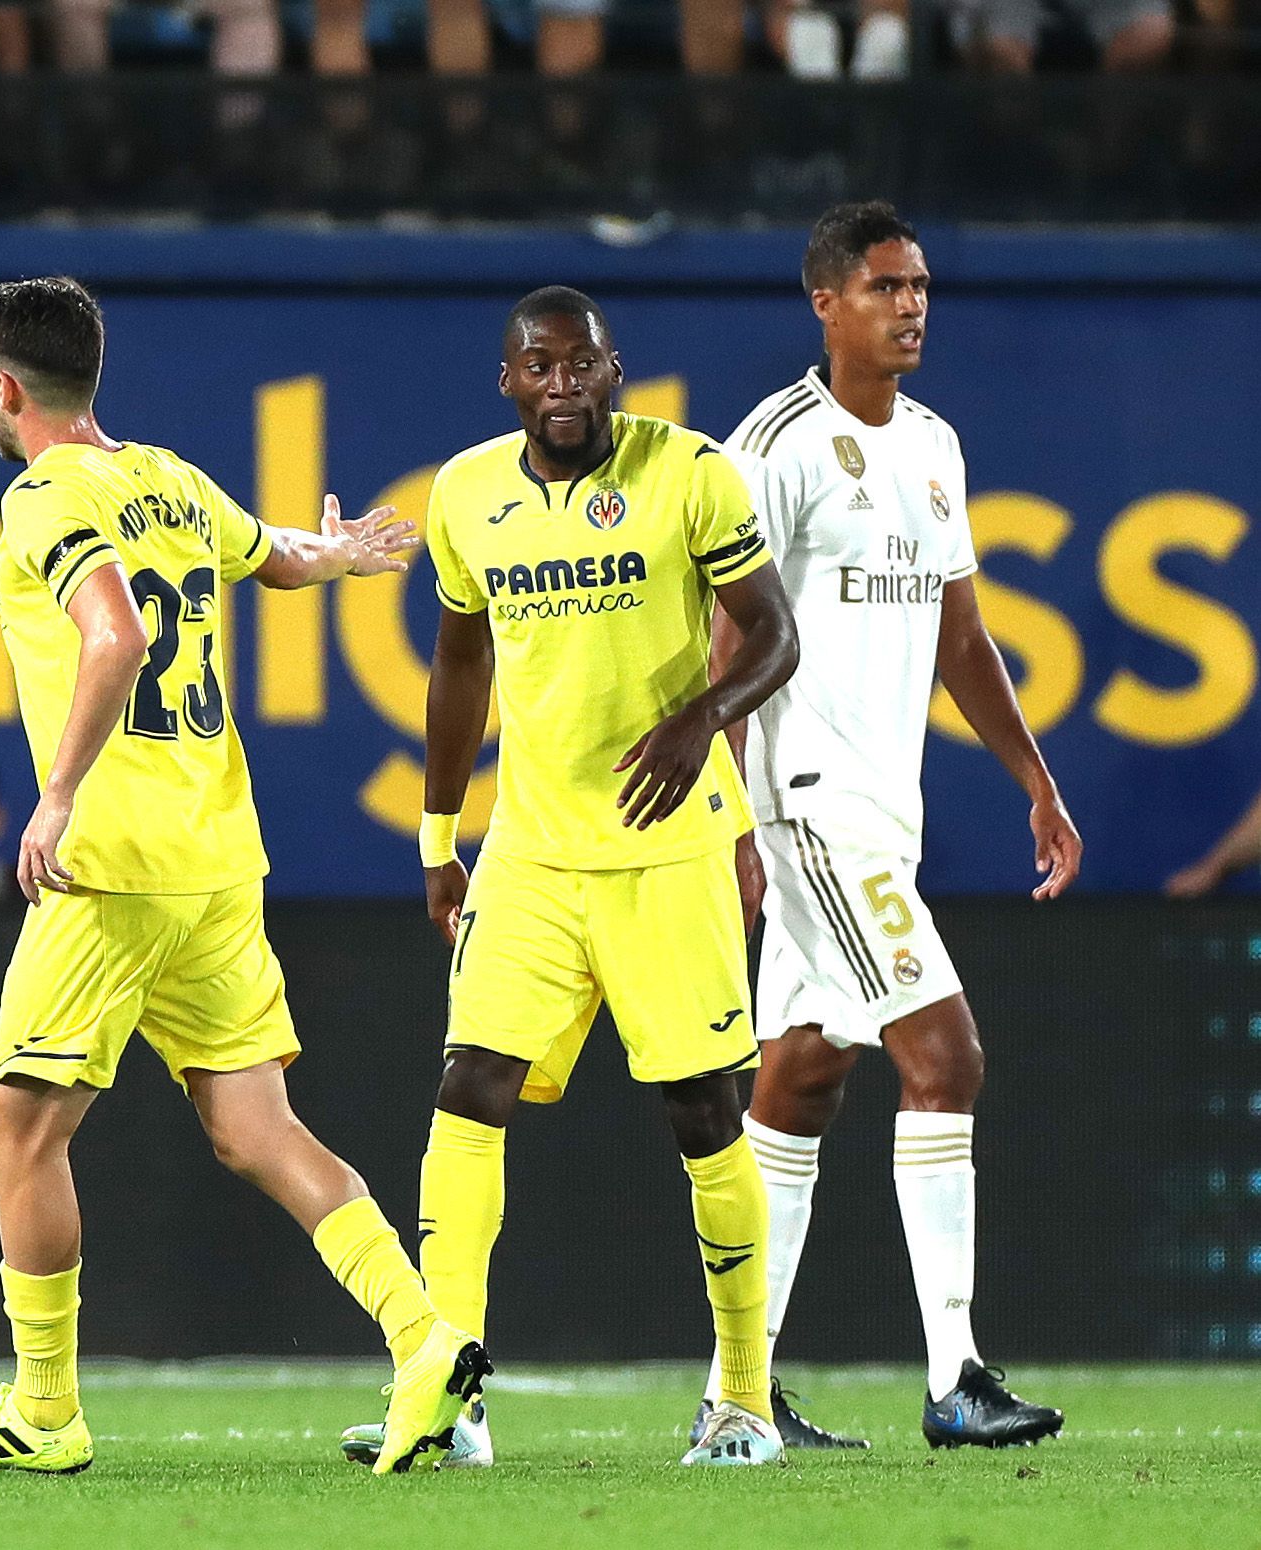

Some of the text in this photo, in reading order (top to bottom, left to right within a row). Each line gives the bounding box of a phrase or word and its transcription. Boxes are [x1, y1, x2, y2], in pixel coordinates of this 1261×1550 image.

[887, 534, 919, 566] Fly
[484, 551, 647, 597] PAMESA
[839, 565, 946, 604] Emirate
[124, 567, 224, 741] 23
[859, 870, 915, 939] 5
